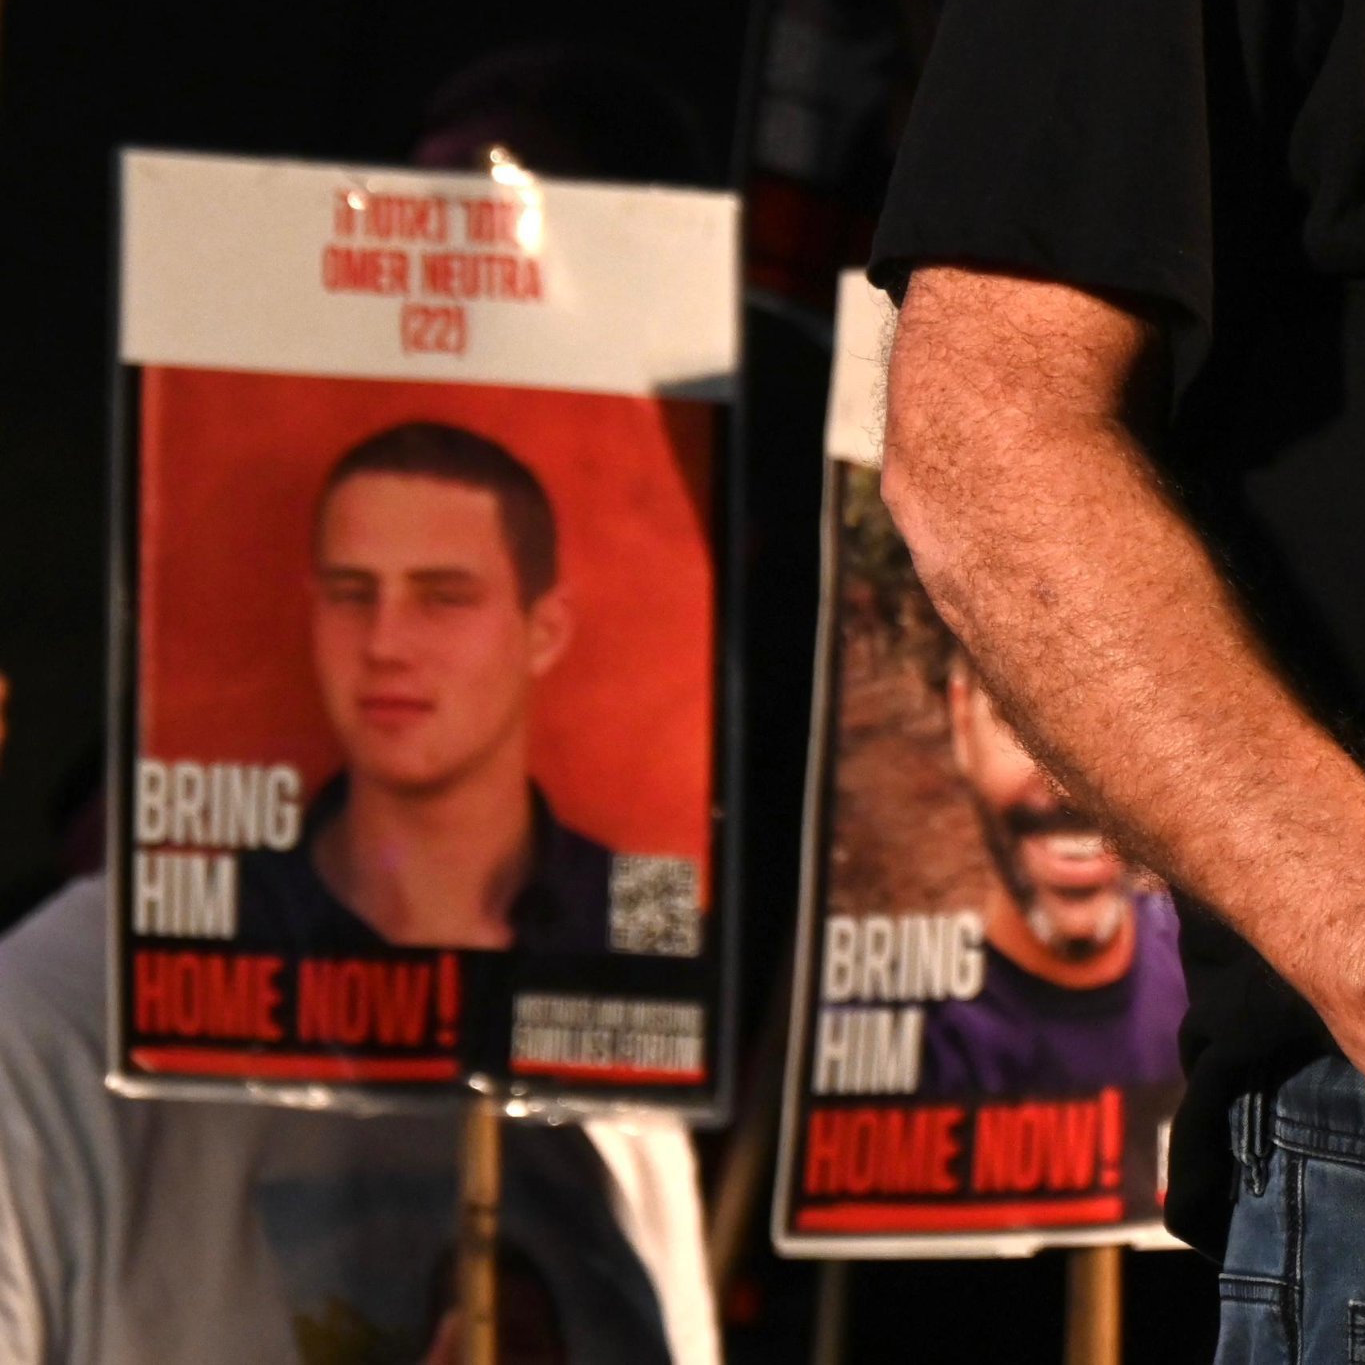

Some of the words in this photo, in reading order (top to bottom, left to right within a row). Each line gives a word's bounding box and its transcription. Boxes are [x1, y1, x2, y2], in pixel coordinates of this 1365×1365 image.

[321, 245, 410, 296] OMER
[421, 251, 543, 303] NEUTRA
[401, 303, 467, 355] (22)
[134, 759, 300, 850] BRING
[132, 848, 237, 940] HIM
[133, 949, 285, 1041] HOME
[299, 950, 460, 1046] NOW!
[822, 910, 987, 1002] BRING
[812, 1005, 926, 1096] HIM
[805, 1106, 966, 1195] HOME
[971, 1086, 1125, 1194] NOW!
